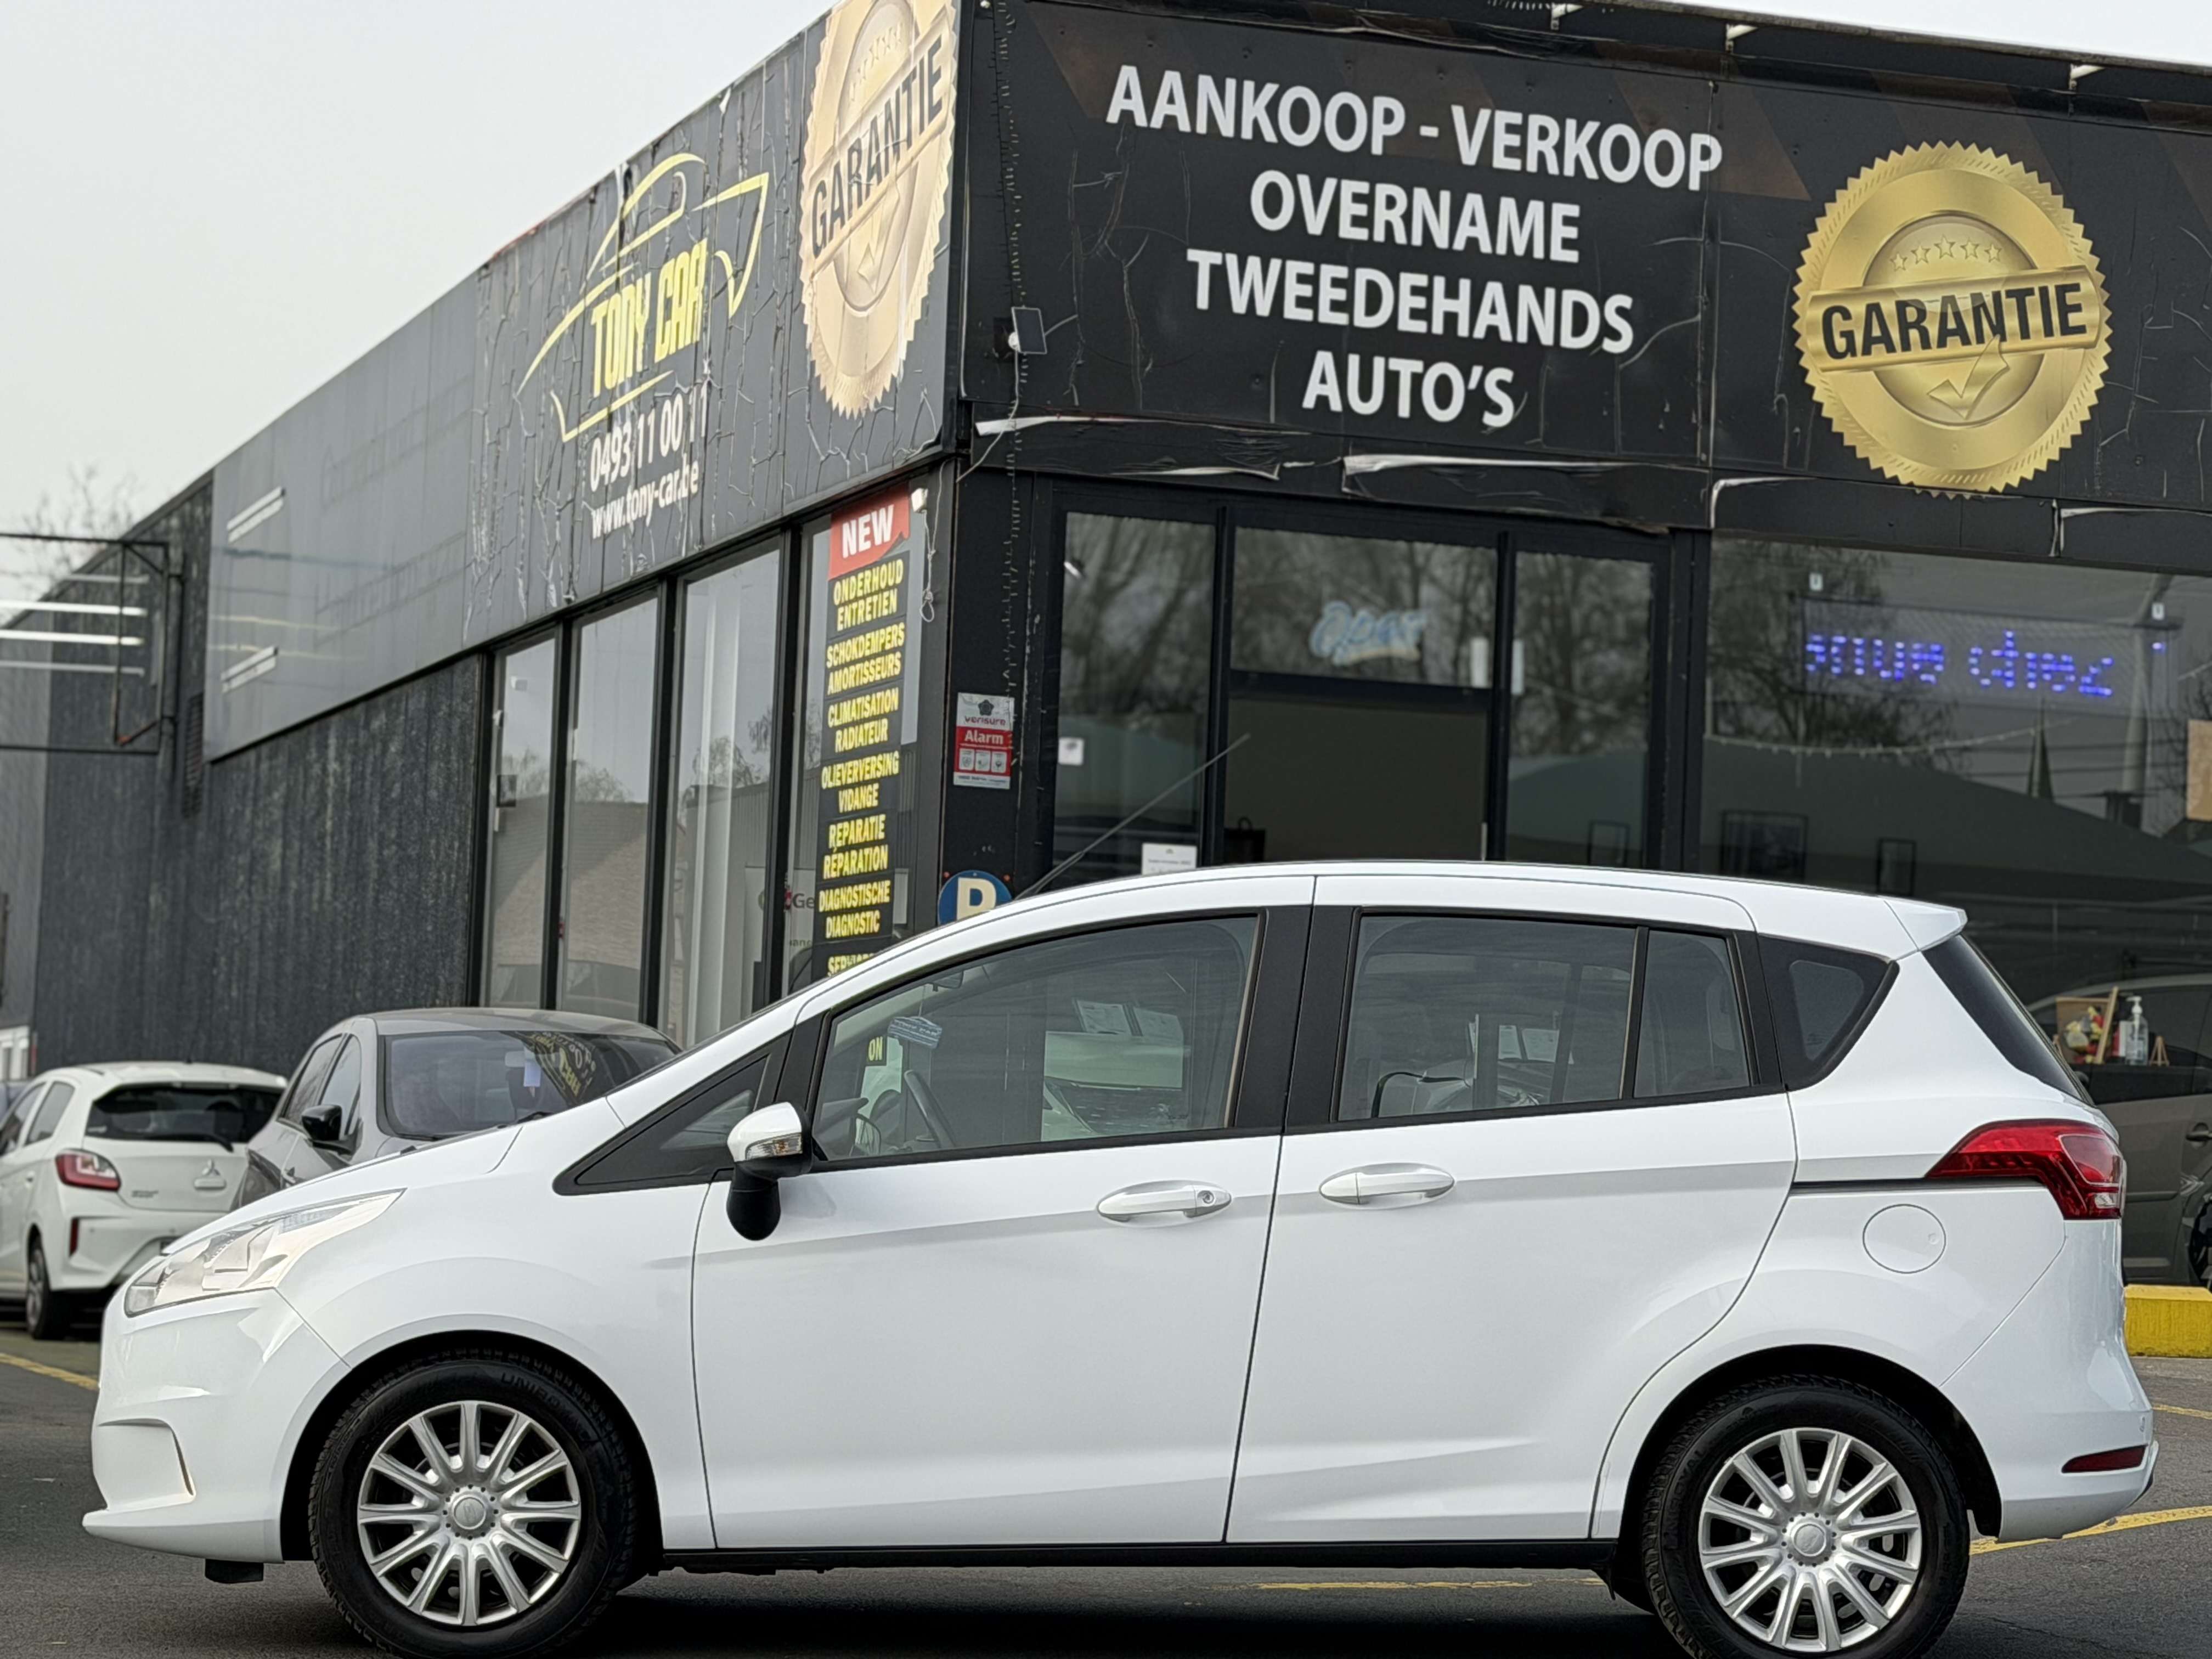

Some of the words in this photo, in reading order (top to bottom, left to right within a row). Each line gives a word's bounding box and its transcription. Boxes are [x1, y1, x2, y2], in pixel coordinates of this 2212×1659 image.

[811, 33, 943, 259] GARANTIE
[1107, 65, 1406, 155] AANKOOP
[1451, 104, 1722, 191] VERKOOP
[1250, 169, 1581, 263] OVERNAME
[590, 272, 652, 398] TONY
[654, 238, 708, 363] CAR
[1186, 248, 1634, 354] TWEEDEHANDS
[1821, 282, 2087, 360] GARANTIE
[1302, 351, 1516, 428] AUTO'S
[590, 420, 633, 493] 0493
[637, 408, 656, 469] 11
[660, 393, 684, 458] 00
[842, 505, 894, 558] NEW
[833, 558, 904, 606] ONDERHOUD
[837, 589, 898, 632] ENTRETIEN
[826, 622, 905, 668] SCHOKDEMPERS
[827, 653, 901, 695] AMORTISSEURS
[827, 688, 899, 729] CLIMATISATION
[964, 715, 1006, 726] verisure
[834, 718, 888, 753] RADIATEUR
[964, 730, 1004, 744] Alarm
[821, 752, 900, 790] OLIEVERVERSING
[838, 783, 879, 814] VIDANGE
[828, 814, 885, 849] REPARATIE
[819, 879, 890, 912] DIAGNOSTISCHE
[825, 910, 881, 939] DIAGNOSTIC
